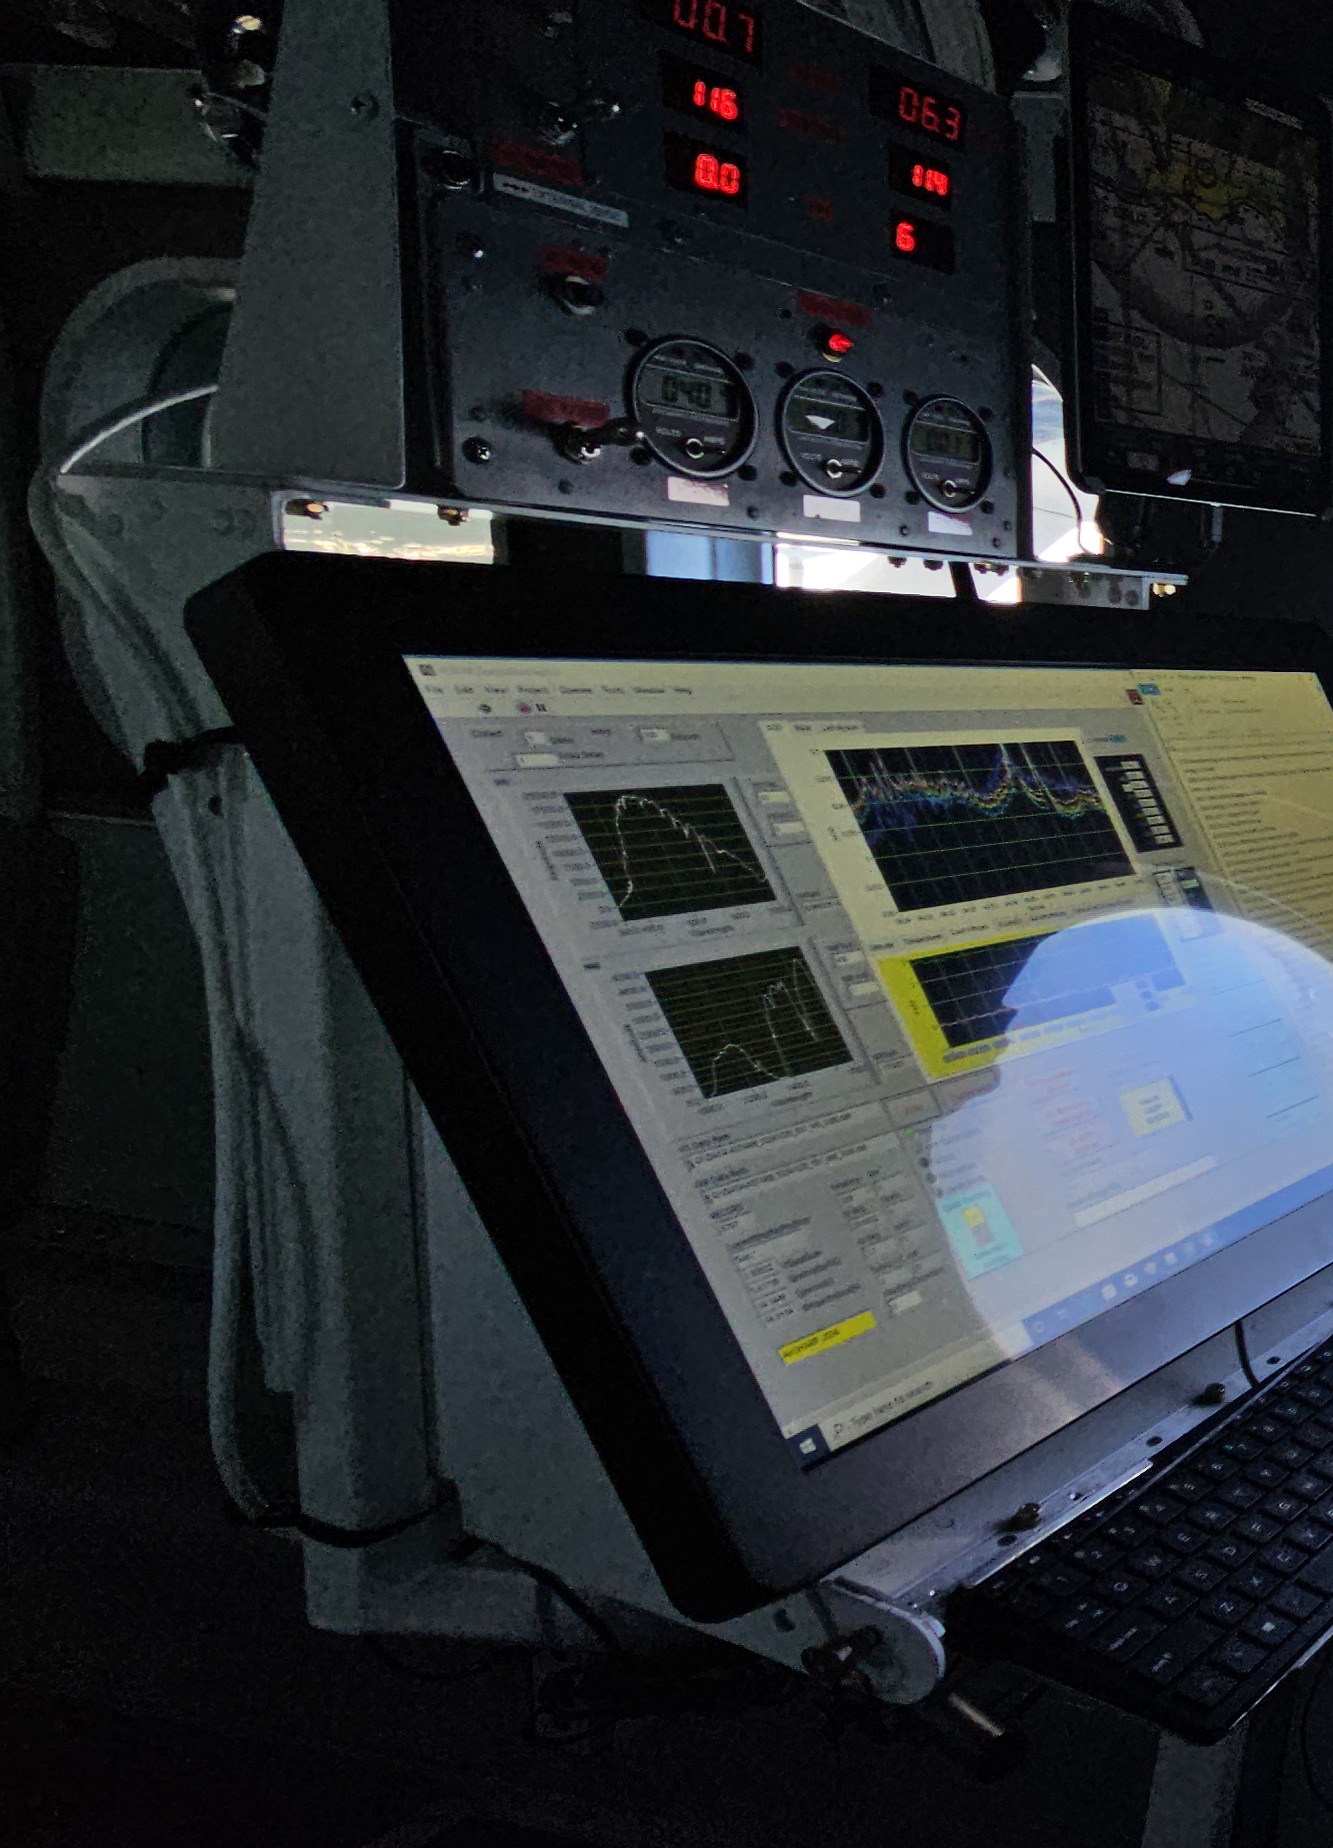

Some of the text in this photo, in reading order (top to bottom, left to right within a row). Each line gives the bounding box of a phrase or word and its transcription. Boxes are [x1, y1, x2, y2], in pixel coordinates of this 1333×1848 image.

[692, 80, 739, 120] 116
[899, 86, 961, 141] 063
[895, 220, 916, 252] 6
